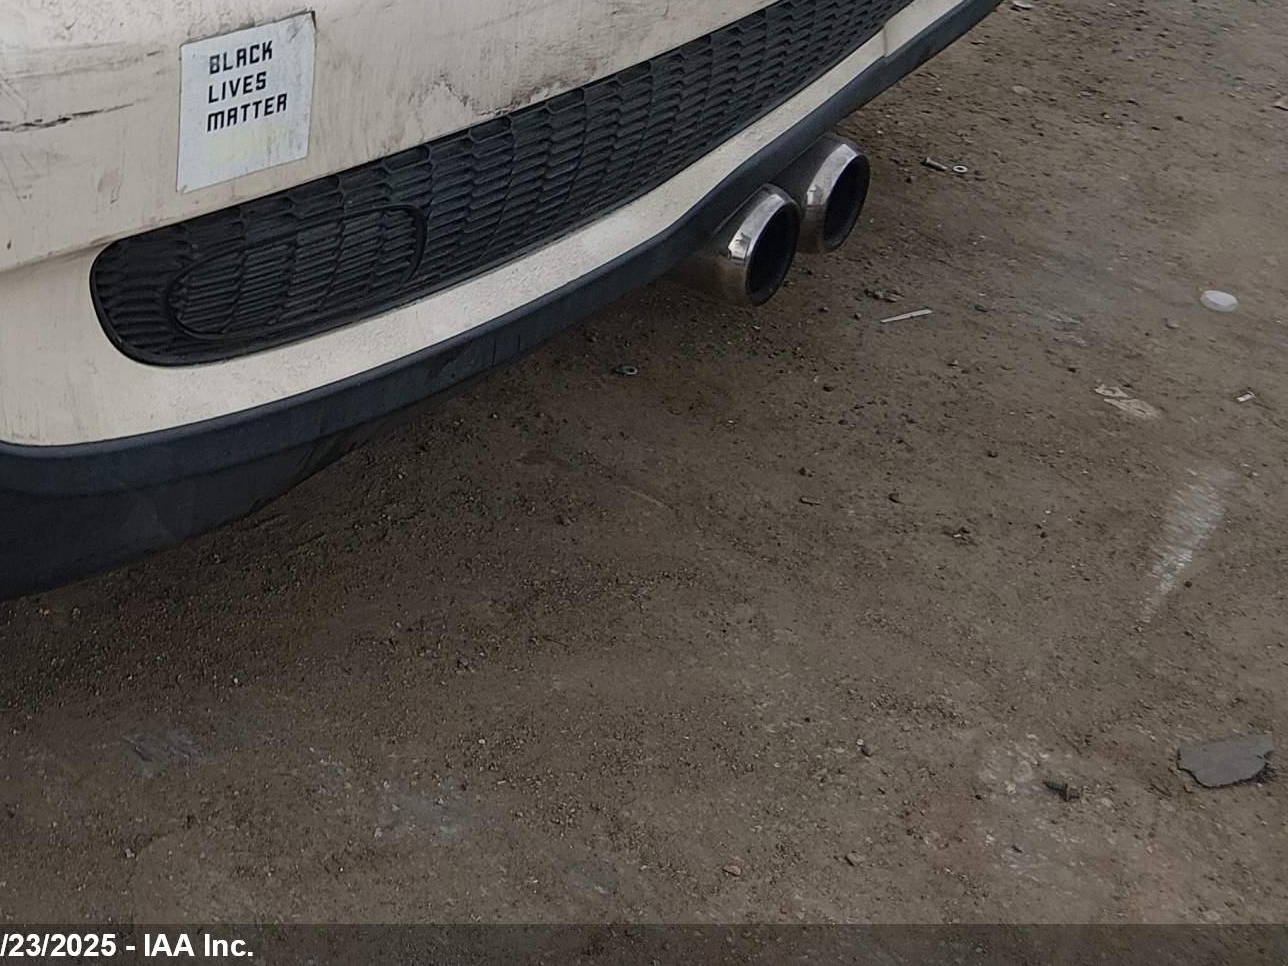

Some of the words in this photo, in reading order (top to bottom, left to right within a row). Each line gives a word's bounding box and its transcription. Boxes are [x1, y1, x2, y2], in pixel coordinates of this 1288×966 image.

[208, 39, 274, 75] BLACK
[207, 70, 268, 104] LIVES
[206, 92, 289, 133] MATTER
